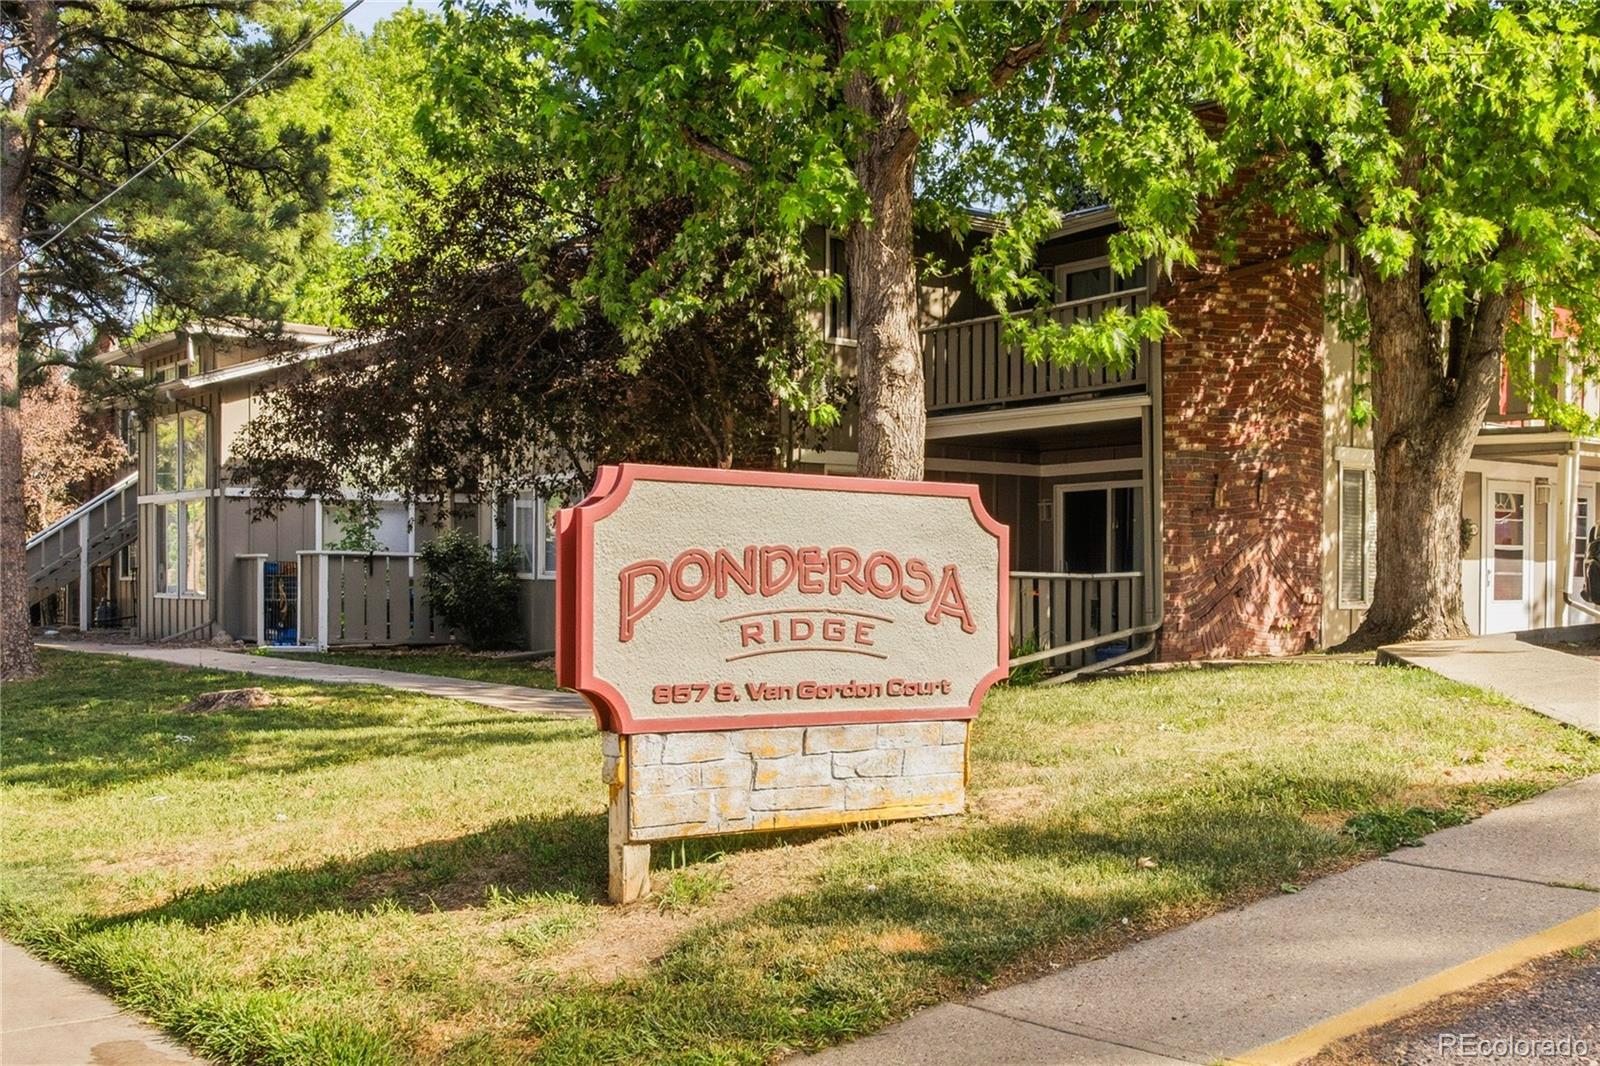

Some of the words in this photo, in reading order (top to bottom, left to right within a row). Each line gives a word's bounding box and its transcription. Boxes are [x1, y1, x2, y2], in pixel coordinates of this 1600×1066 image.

[619, 545, 977, 642] PONDEROSA
[740, 617, 876, 647] RIDGE
[652, 684, 710, 704] 857
[714, 683, 739, 703] S.
[745, 682, 793, 701] Van
[797, 680, 883, 700] Gordon
[886, 678, 951, 697] Court
